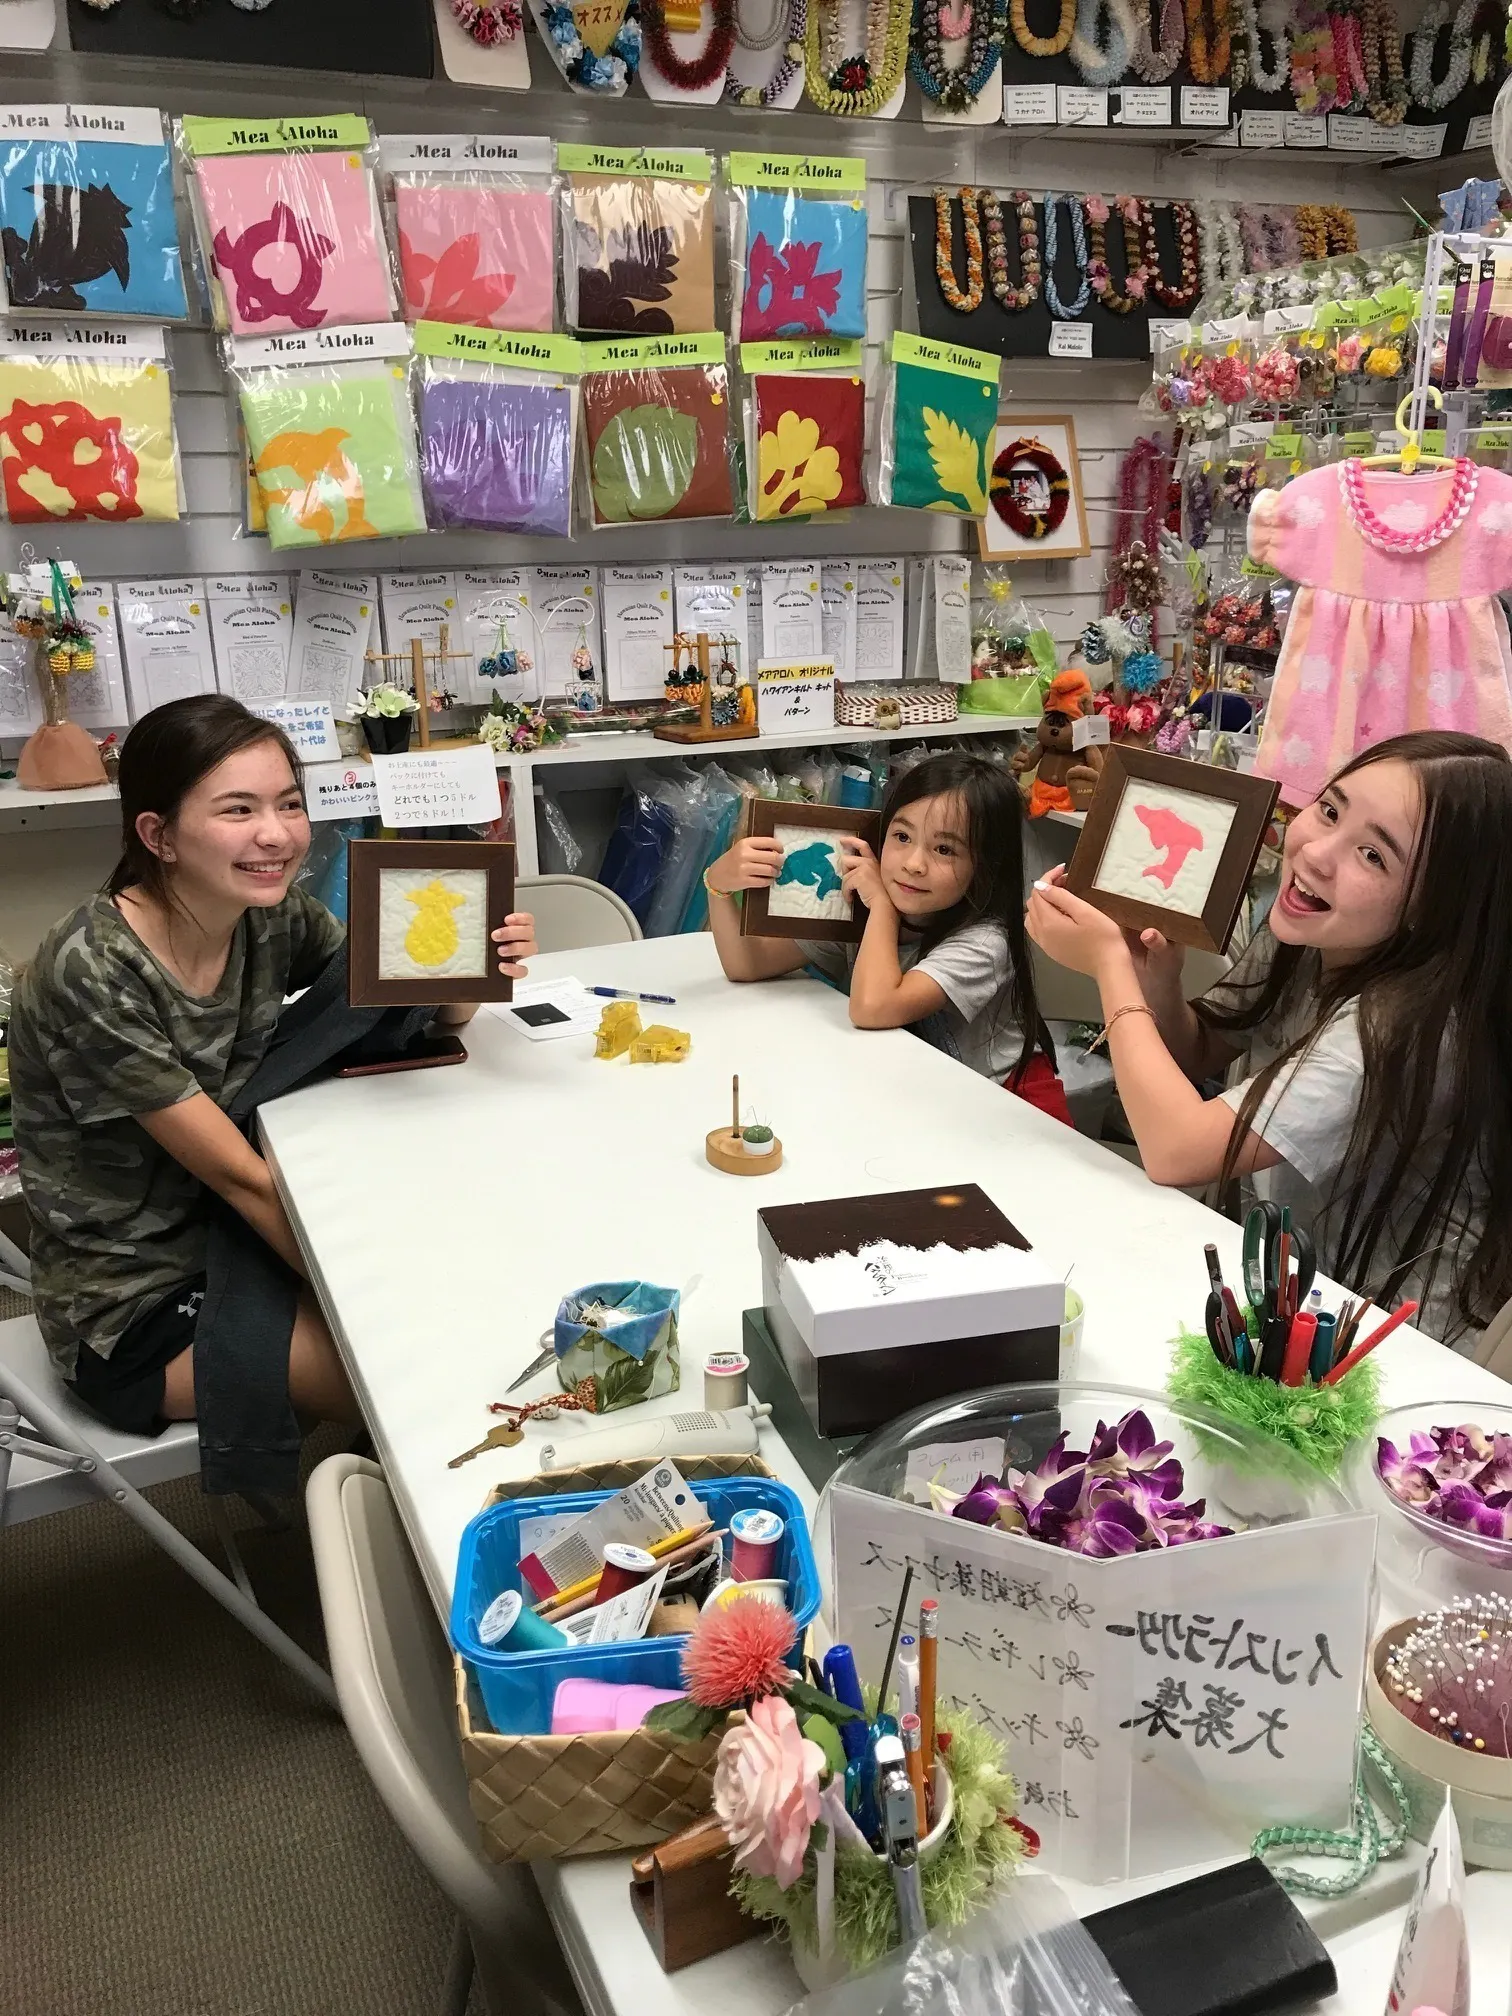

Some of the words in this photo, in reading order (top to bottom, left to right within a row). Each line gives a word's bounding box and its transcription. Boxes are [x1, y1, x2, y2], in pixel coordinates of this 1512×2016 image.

[577, 5, 623, 27] オススメ
[2, 113, 50, 128] Mea
[64, 114, 126, 131] Aloha
[227, 130, 270, 146] Mea
[282, 125, 339, 141] Aloha
[409, 144, 451, 159] Mea
[463, 144, 519, 159] Aloha
[587, 154, 624, 169] Mea
[636, 157, 684, 174] Aloha
[757, 162, 790, 176] Mea
[799, 164, 842, 178] Aloha
[6, 328, 53, 343] Mea
[66, 329, 128, 345] Aloha
[264, 337, 307, 352] Mea
[319, 334, 375, 349] Aloha
[446, 333, 488, 351] Mea
[498, 340, 552, 359] Aloha
[602, 346, 639, 361] Mea
[650, 342, 698, 357] Aloha
[765, 349, 794, 362] Mea
[802, 345, 841, 359] Aloha
[913, 345, 941, 361] Mea
[947, 352, 983, 370] Aloha
[315, 577, 334, 587] Mea
[395, 581, 414, 589] Mea
[687, 574, 704, 582] Mea
[709, 573, 732, 581] Aloha
[221, 584, 241, 593] Mea
[880, 588, 895, 602] Patterns
[223, 608, 246, 625] Hawaiian
[261, 606, 282, 622] Patterns
[307, 612, 330, 624] Hawaiian
[329, 612, 342, 621] Quilt
[342, 616, 358, 634] Patterns
[313, 623, 329, 632] Mea
[329, 627, 352, 636] Aloha
[757, 668, 795, 680] メアアロハ
[799, 665, 835, 677] オリジナル
[761, 683, 813, 696] ハワイアンキルト
[815, 682, 832, 691] キット
[793, 695, 801, 704] &
[391, 780, 461, 791] キーホルダーにしても
[620, 1493, 632, 1505] 20
[652, 1485, 685, 1533] Betweens/Quilting
[660, 1516, 677, 1535] piquer
